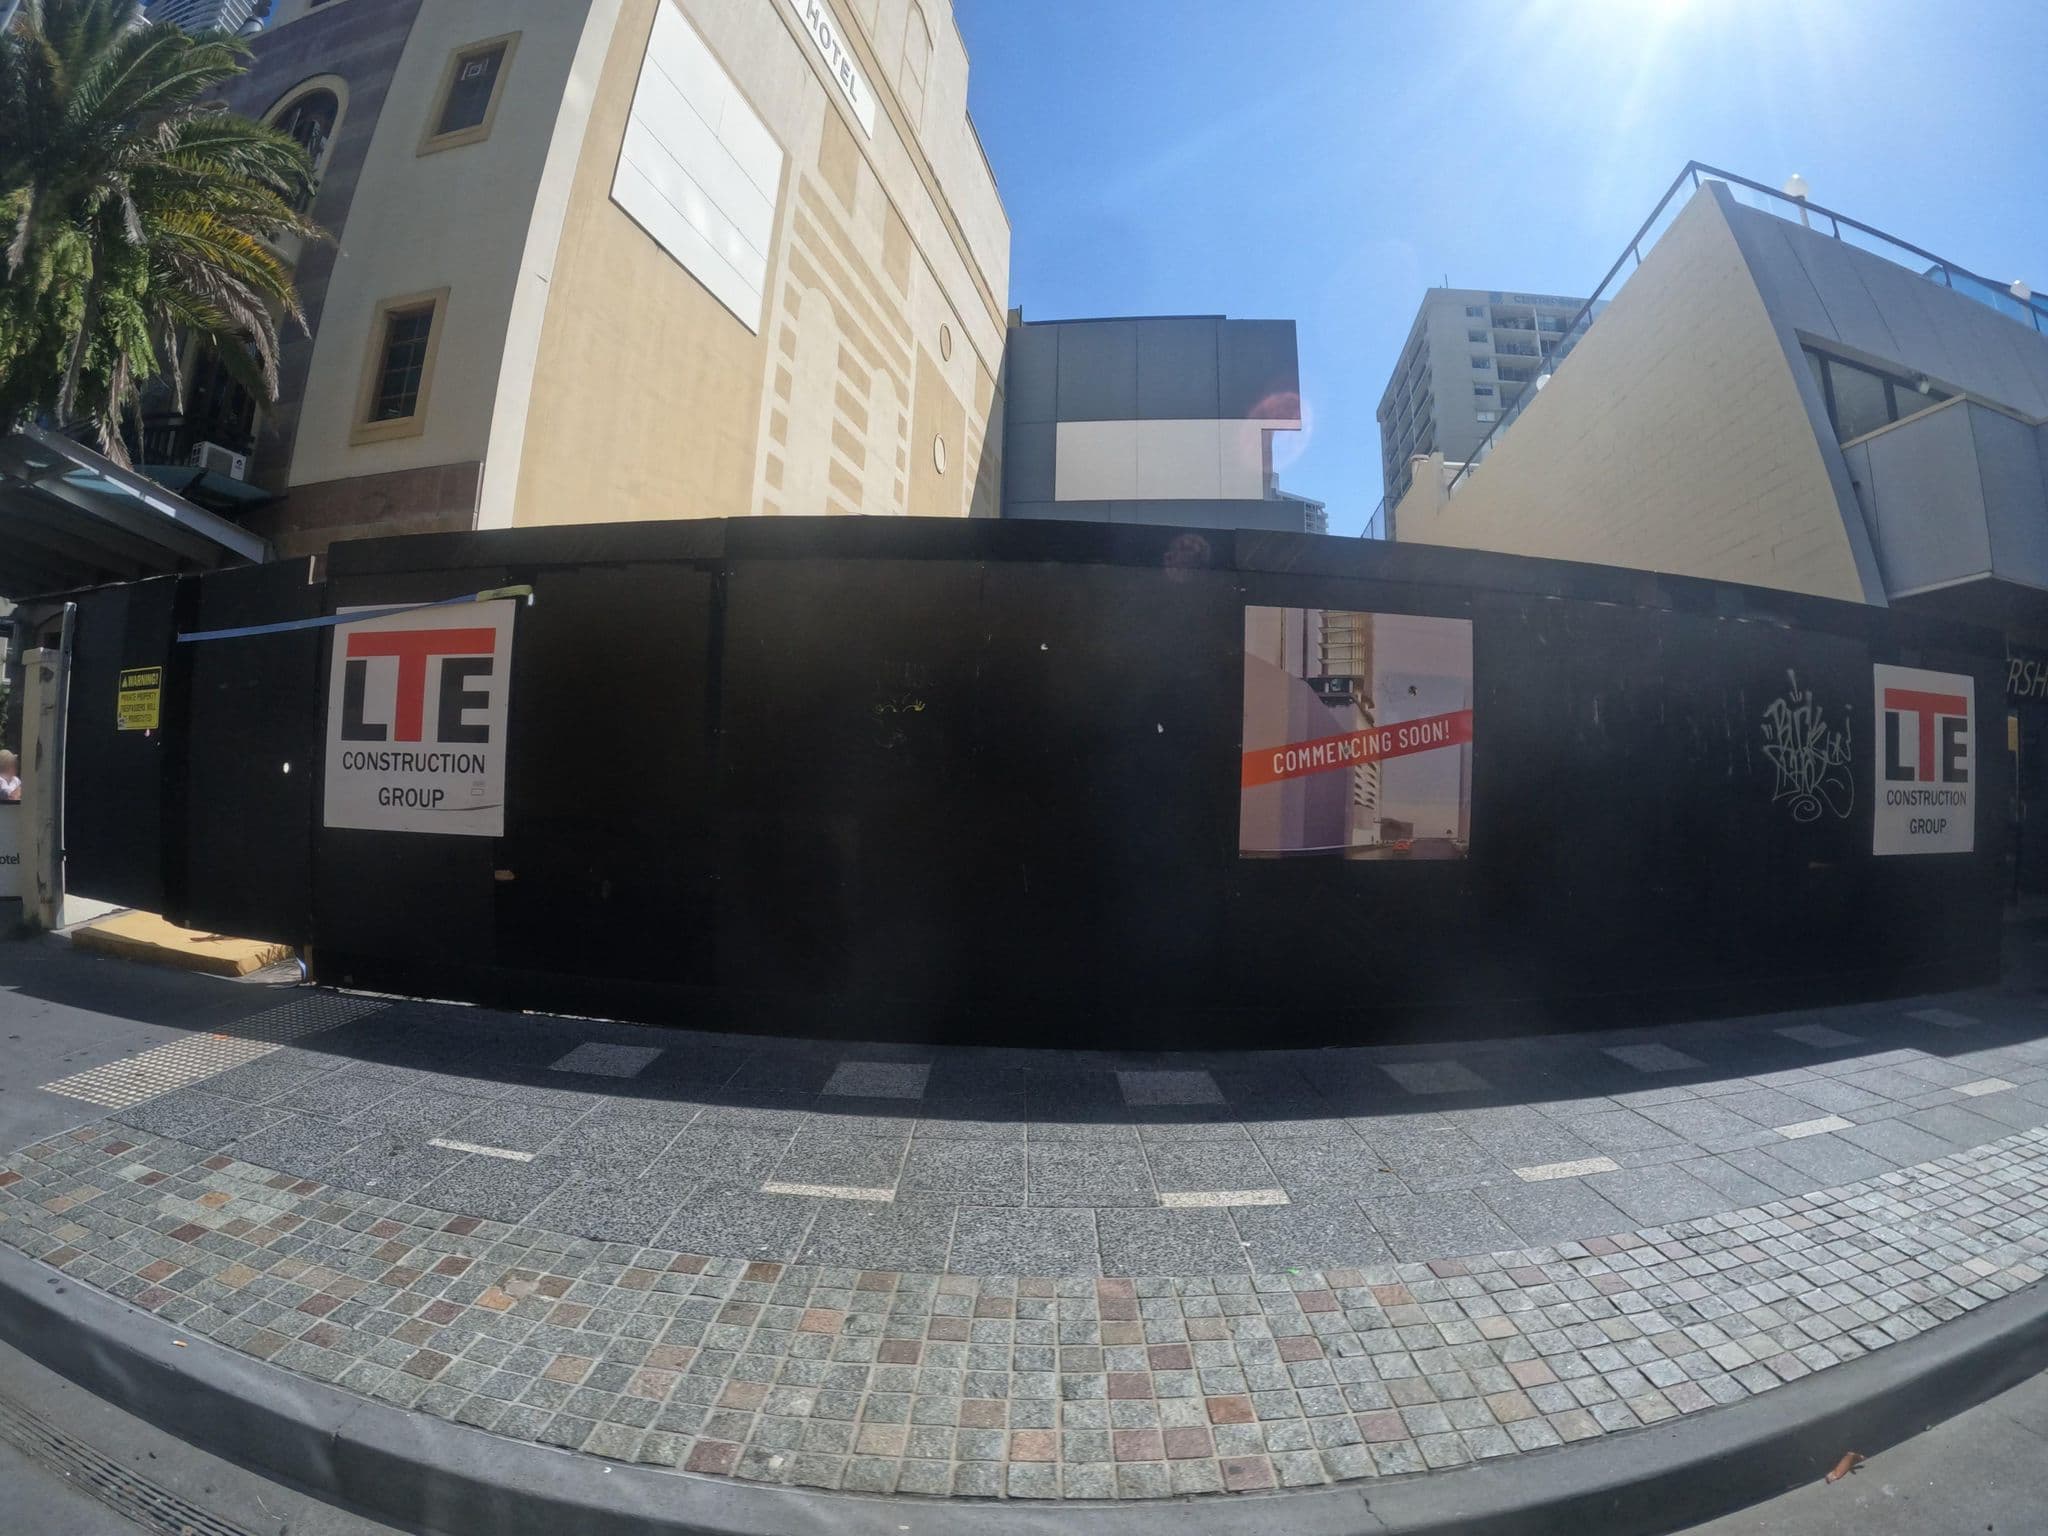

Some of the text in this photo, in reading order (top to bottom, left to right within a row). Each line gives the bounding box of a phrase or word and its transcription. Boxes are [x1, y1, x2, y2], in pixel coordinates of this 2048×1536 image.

[806, 0, 857, 102] HOTEL
[341, 628, 496, 743] LTE
[2006, 658, 2048, 698] RSH
[1272, 719, 1450, 774] COMMENCING SOON!
[1884, 688, 1968, 783] LTE
[342, 751, 485, 774] CONSTRUCTION
[378, 787, 444, 808] GROUP
[1886, 790, 1967, 806] CONSTRUCTION
[1909, 818, 1947, 834] GROUP
